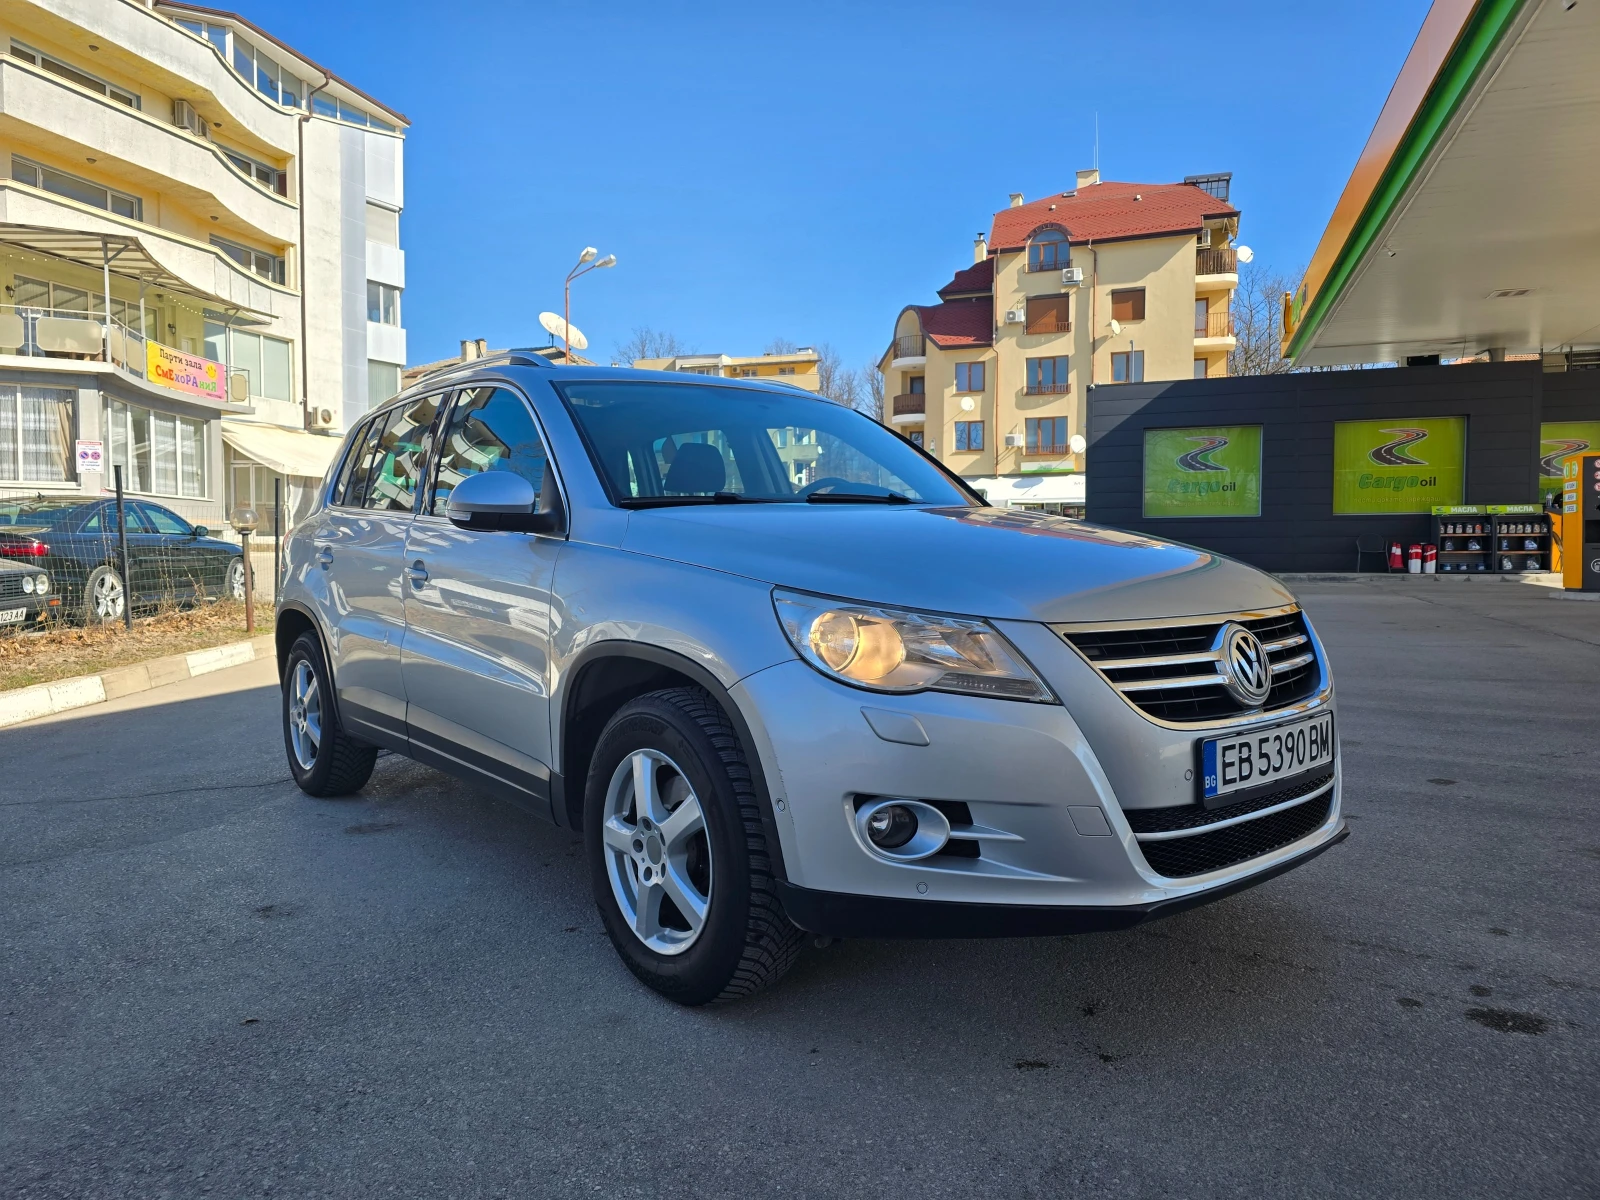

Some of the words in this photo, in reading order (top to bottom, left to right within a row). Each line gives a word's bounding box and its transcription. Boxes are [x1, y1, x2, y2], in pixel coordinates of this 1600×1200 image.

[160, 348, 183, 364] Парти
[184, 359, 203, 371] зала
[1167, 479, 1221, 497] Cargo
[1221, 481, 1237, 492] oil
[1359, 473, 1420, 492] Cargo
[1420, 476, 1437, 487] oil
[1450, 506, 1478, 514] МАСЛА
[1506, 505, 1534, 513] МАСЛА
[0, 611, 13, 621] 123
[1221, 741, 1254, 787] EB
[1258, 728, 1306, 777] 5390
[1309, 720, 1330, 762] BM
[1204, 774, 1217, 789] BG
